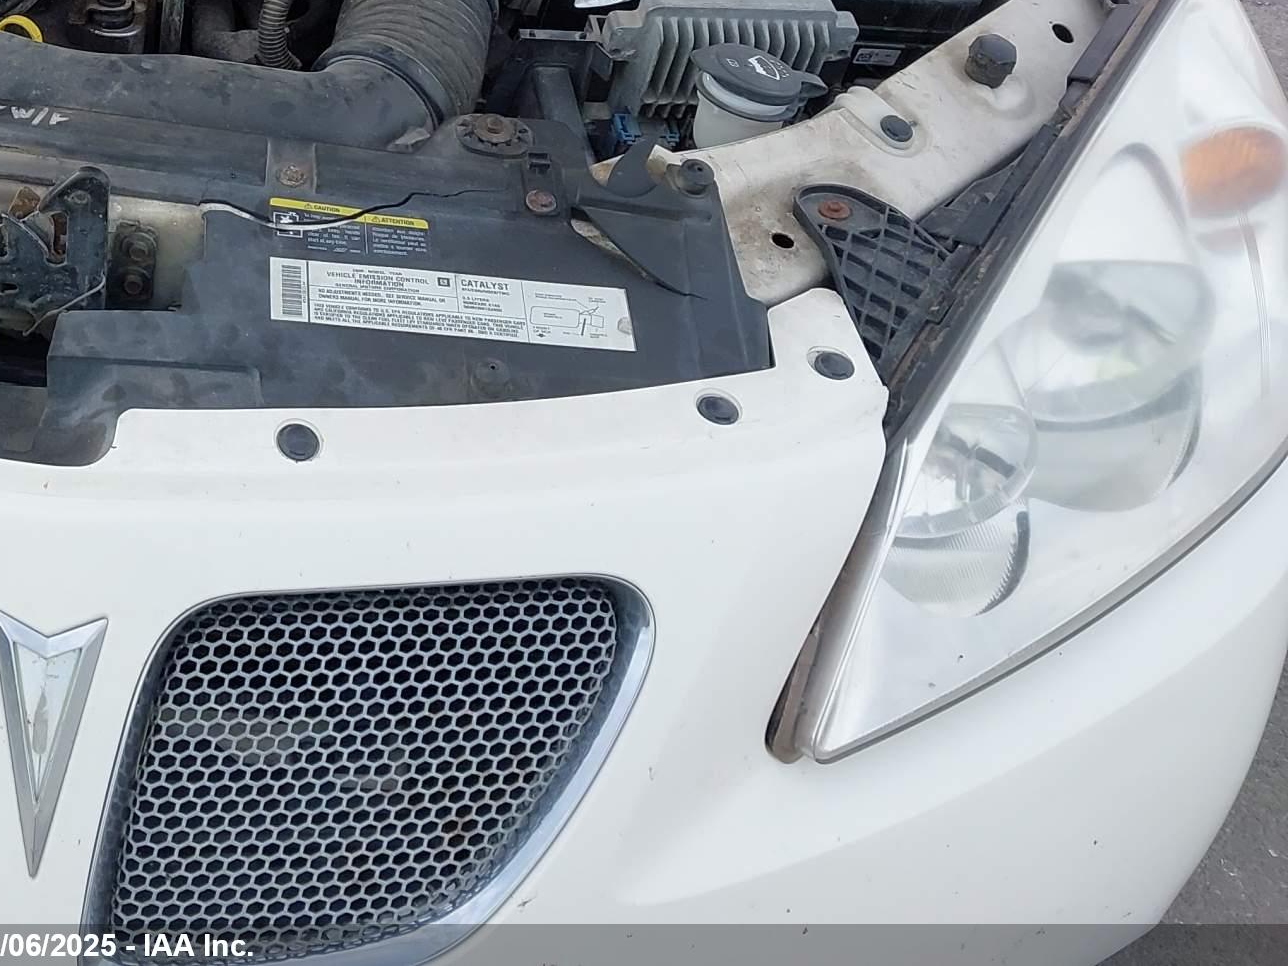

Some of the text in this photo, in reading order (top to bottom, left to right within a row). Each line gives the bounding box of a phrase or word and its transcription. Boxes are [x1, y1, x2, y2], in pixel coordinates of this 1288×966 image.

[313, 204, 341, 213] CAUTION
[381, 217, 415, 226] ATTENTION
[326, 270, 355, 279] VEHICLE
[358, 272, 393, 281] EMISSION
[395, 276, 430, 284] CONTROL
[354, 278, 404, 287] INFORMATION
[461, 279, 509, 290] CATALYST
